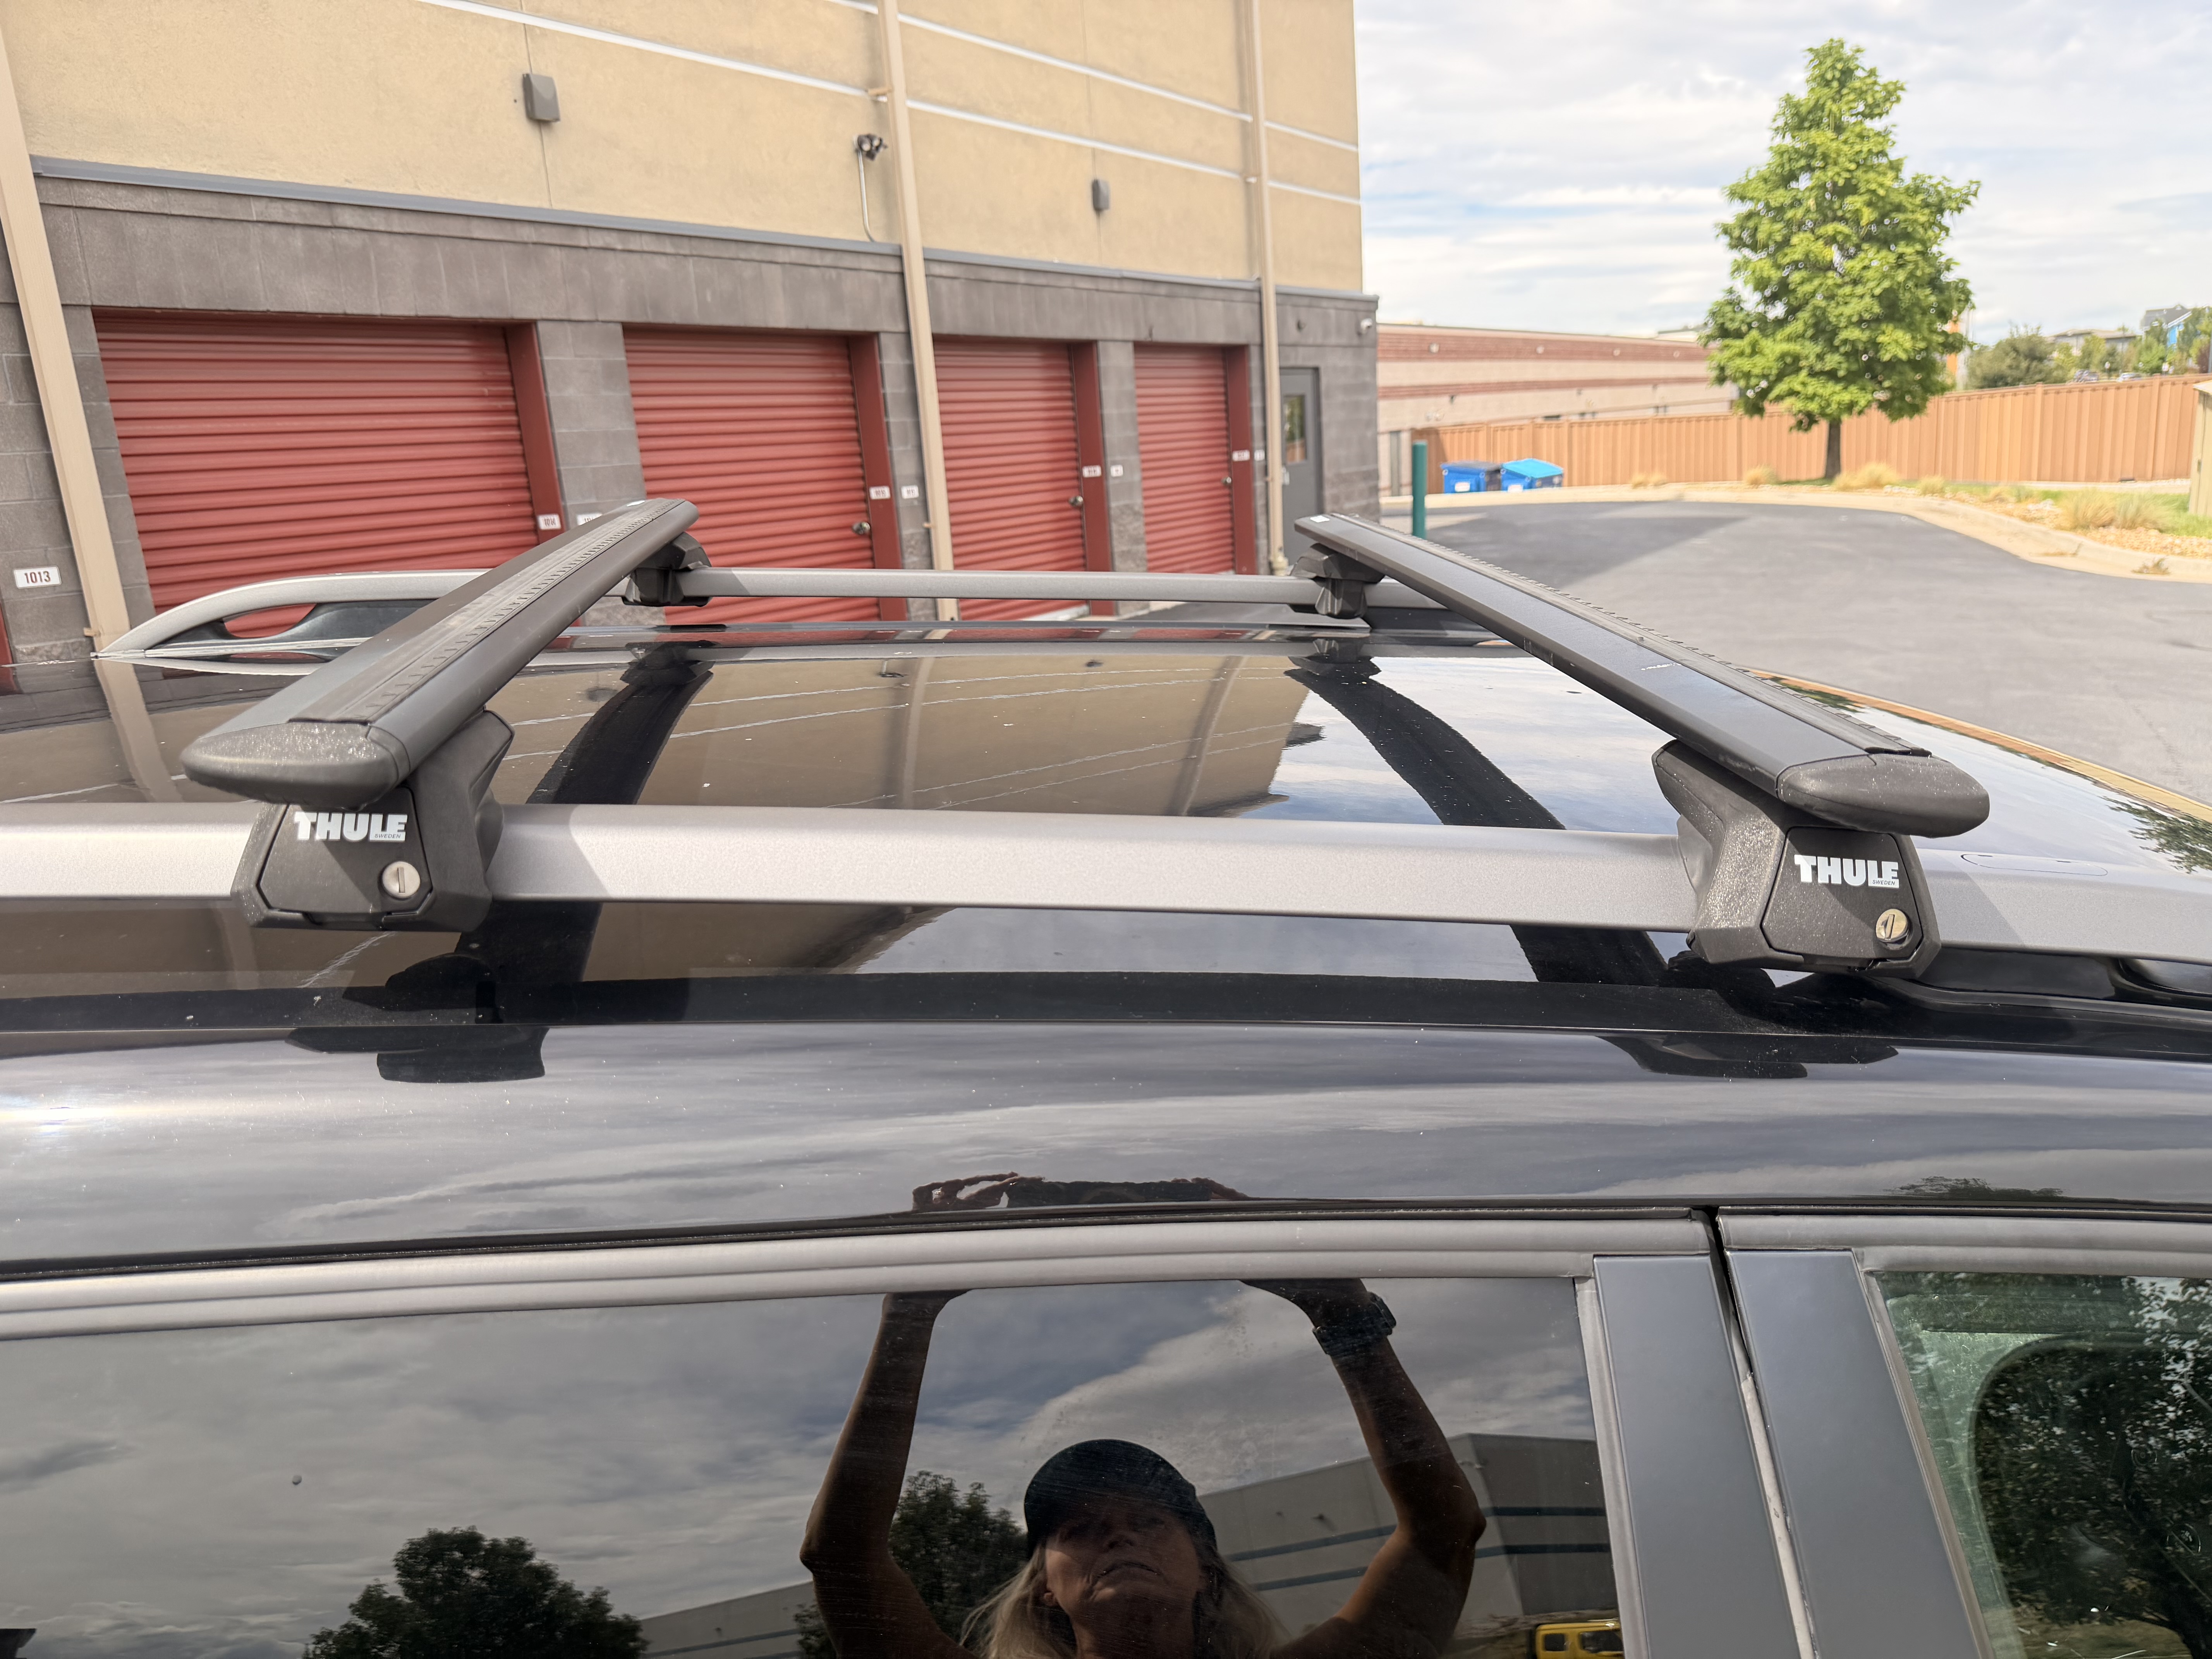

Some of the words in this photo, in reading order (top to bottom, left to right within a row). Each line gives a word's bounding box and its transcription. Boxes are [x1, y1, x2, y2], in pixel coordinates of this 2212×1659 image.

[24, 570, 51, 584] 1013
[294, 811, 408, 842] THULE
[1794, 854, 1900, 888] THULE
